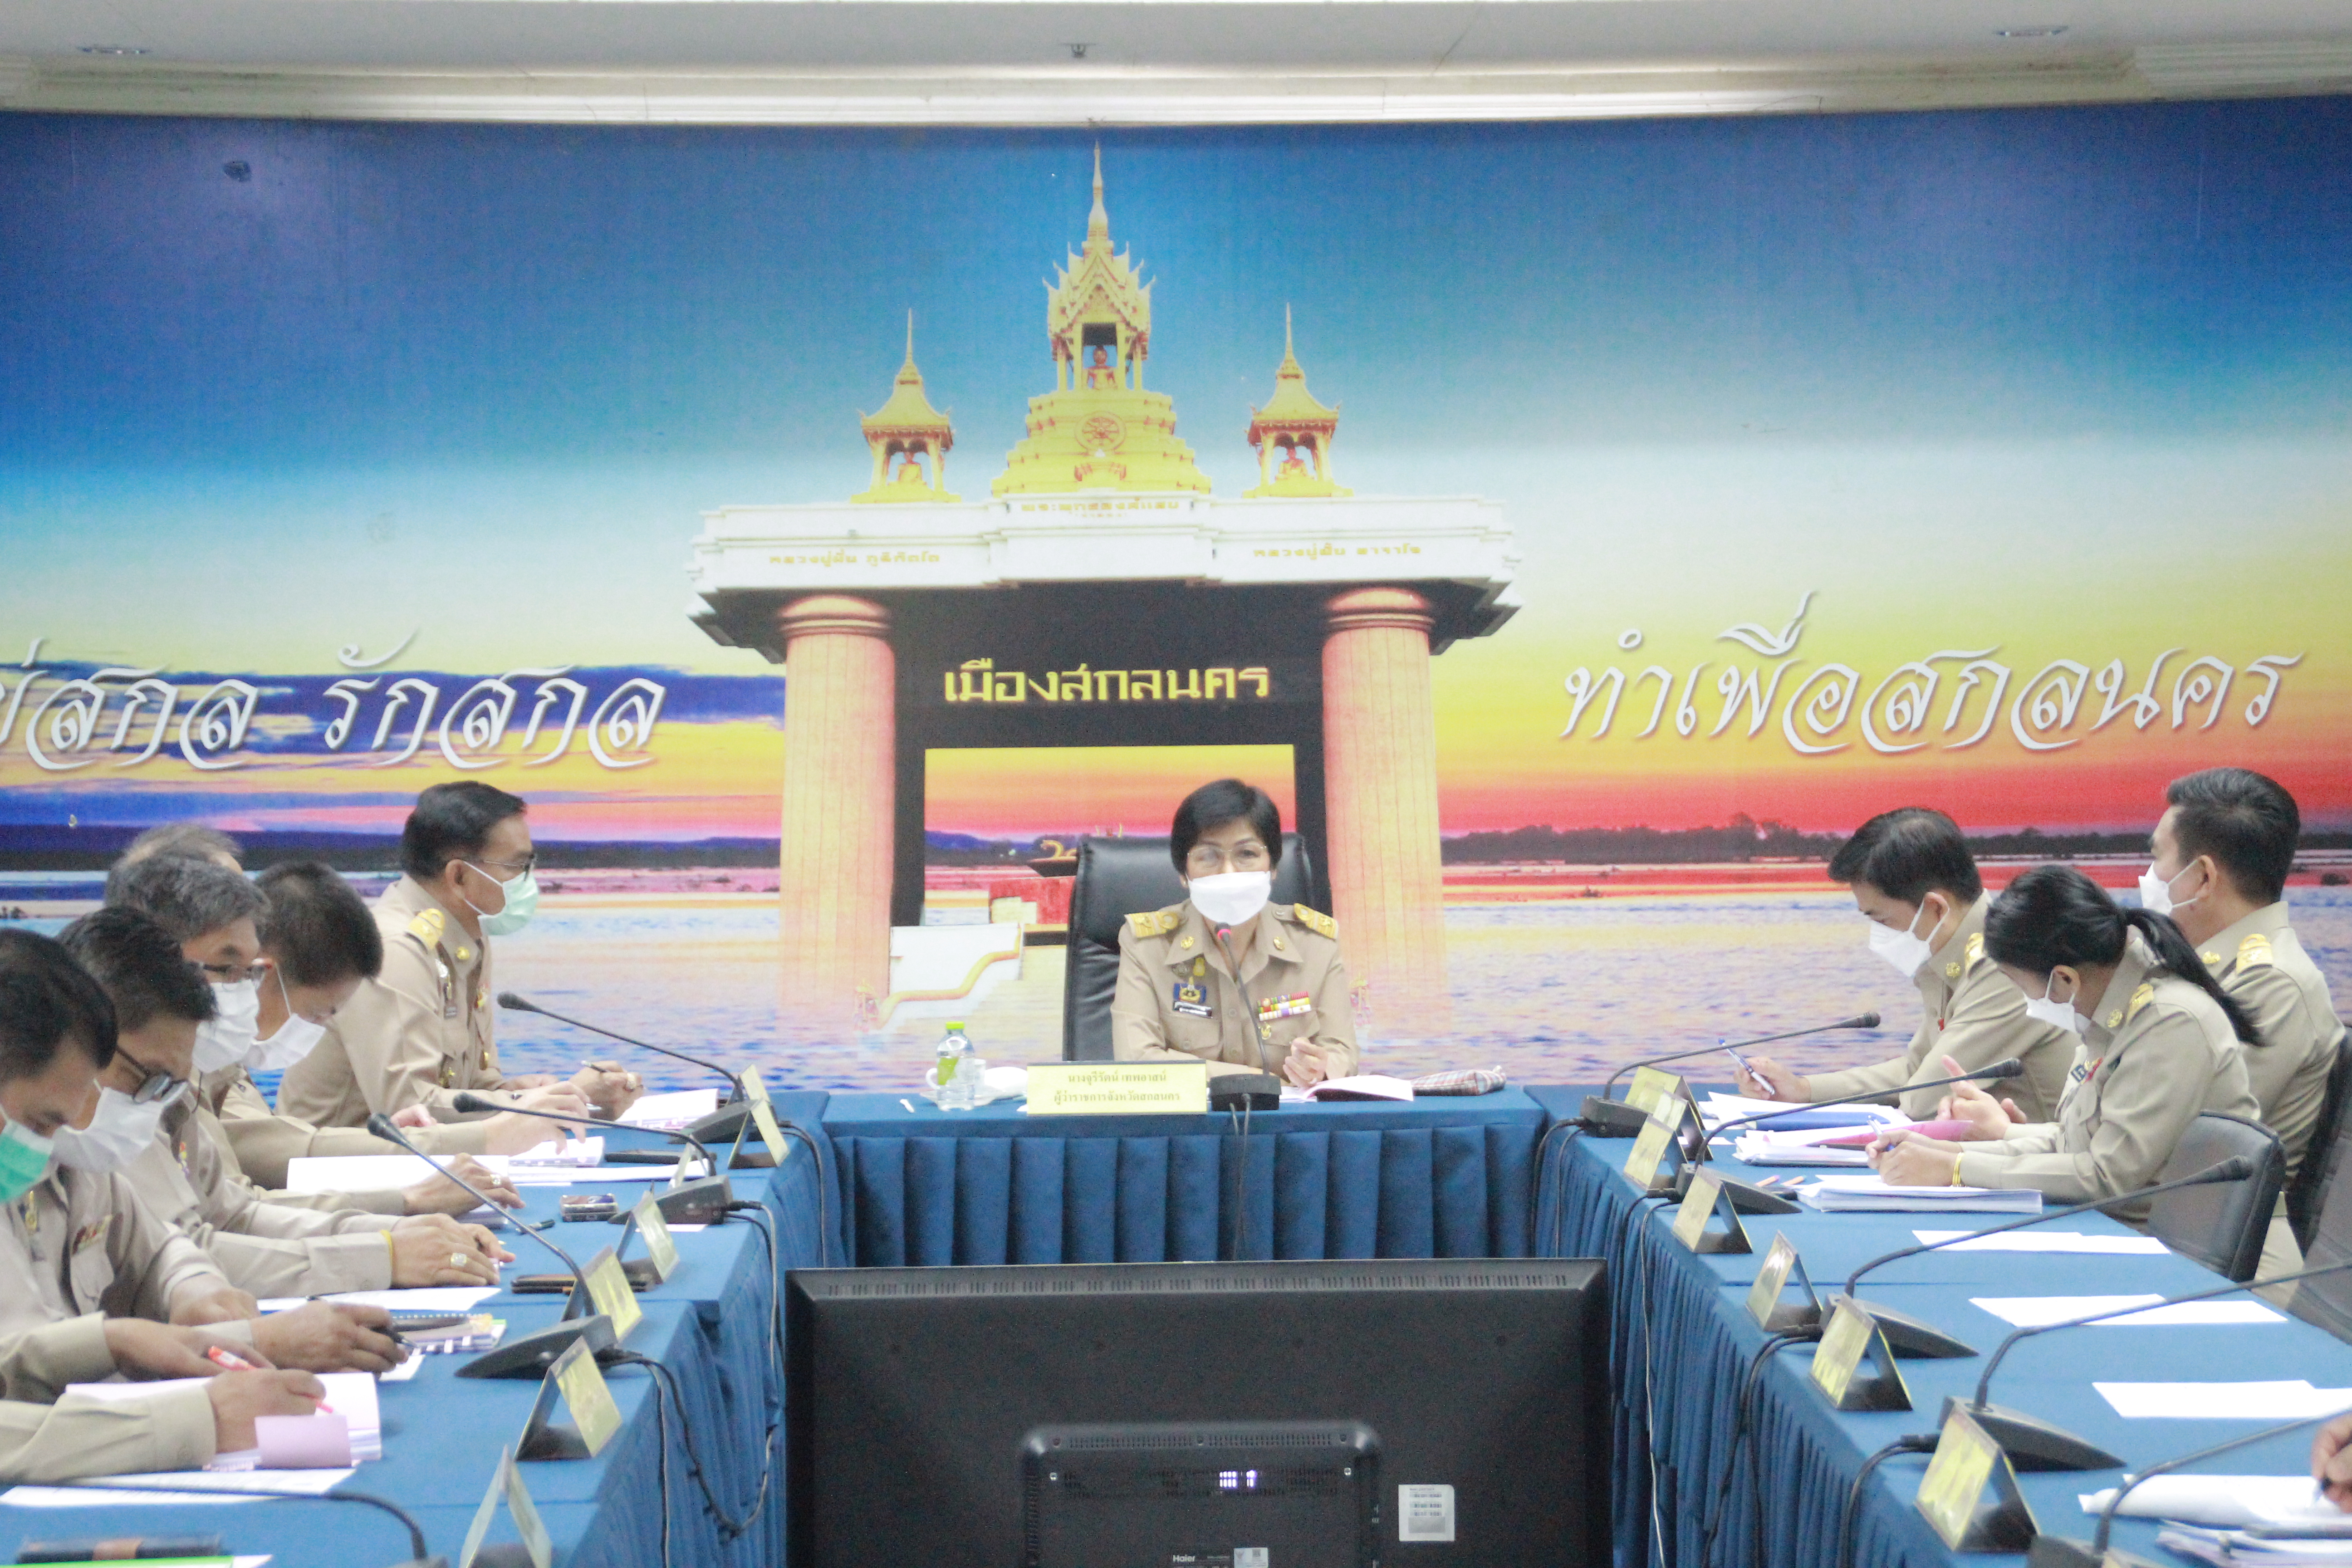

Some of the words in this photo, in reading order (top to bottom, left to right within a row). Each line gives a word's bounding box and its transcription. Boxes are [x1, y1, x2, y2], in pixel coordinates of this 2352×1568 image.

[944, 658, 1269, 701] เมืองสกลนคร
[1560, 591, 2303, 754] ทำเพื่อสกลนคร
[323, 626, 668, 770] รักสกล
[1054, 1090, 1180, 1105] ผู้ว่าราชการจังหวัดสกลนคร
[1068, 1070, 1118, 1086] นางจุรีรัตน์
[1122, 1069, 1166, 1082] เทพอาสน์
